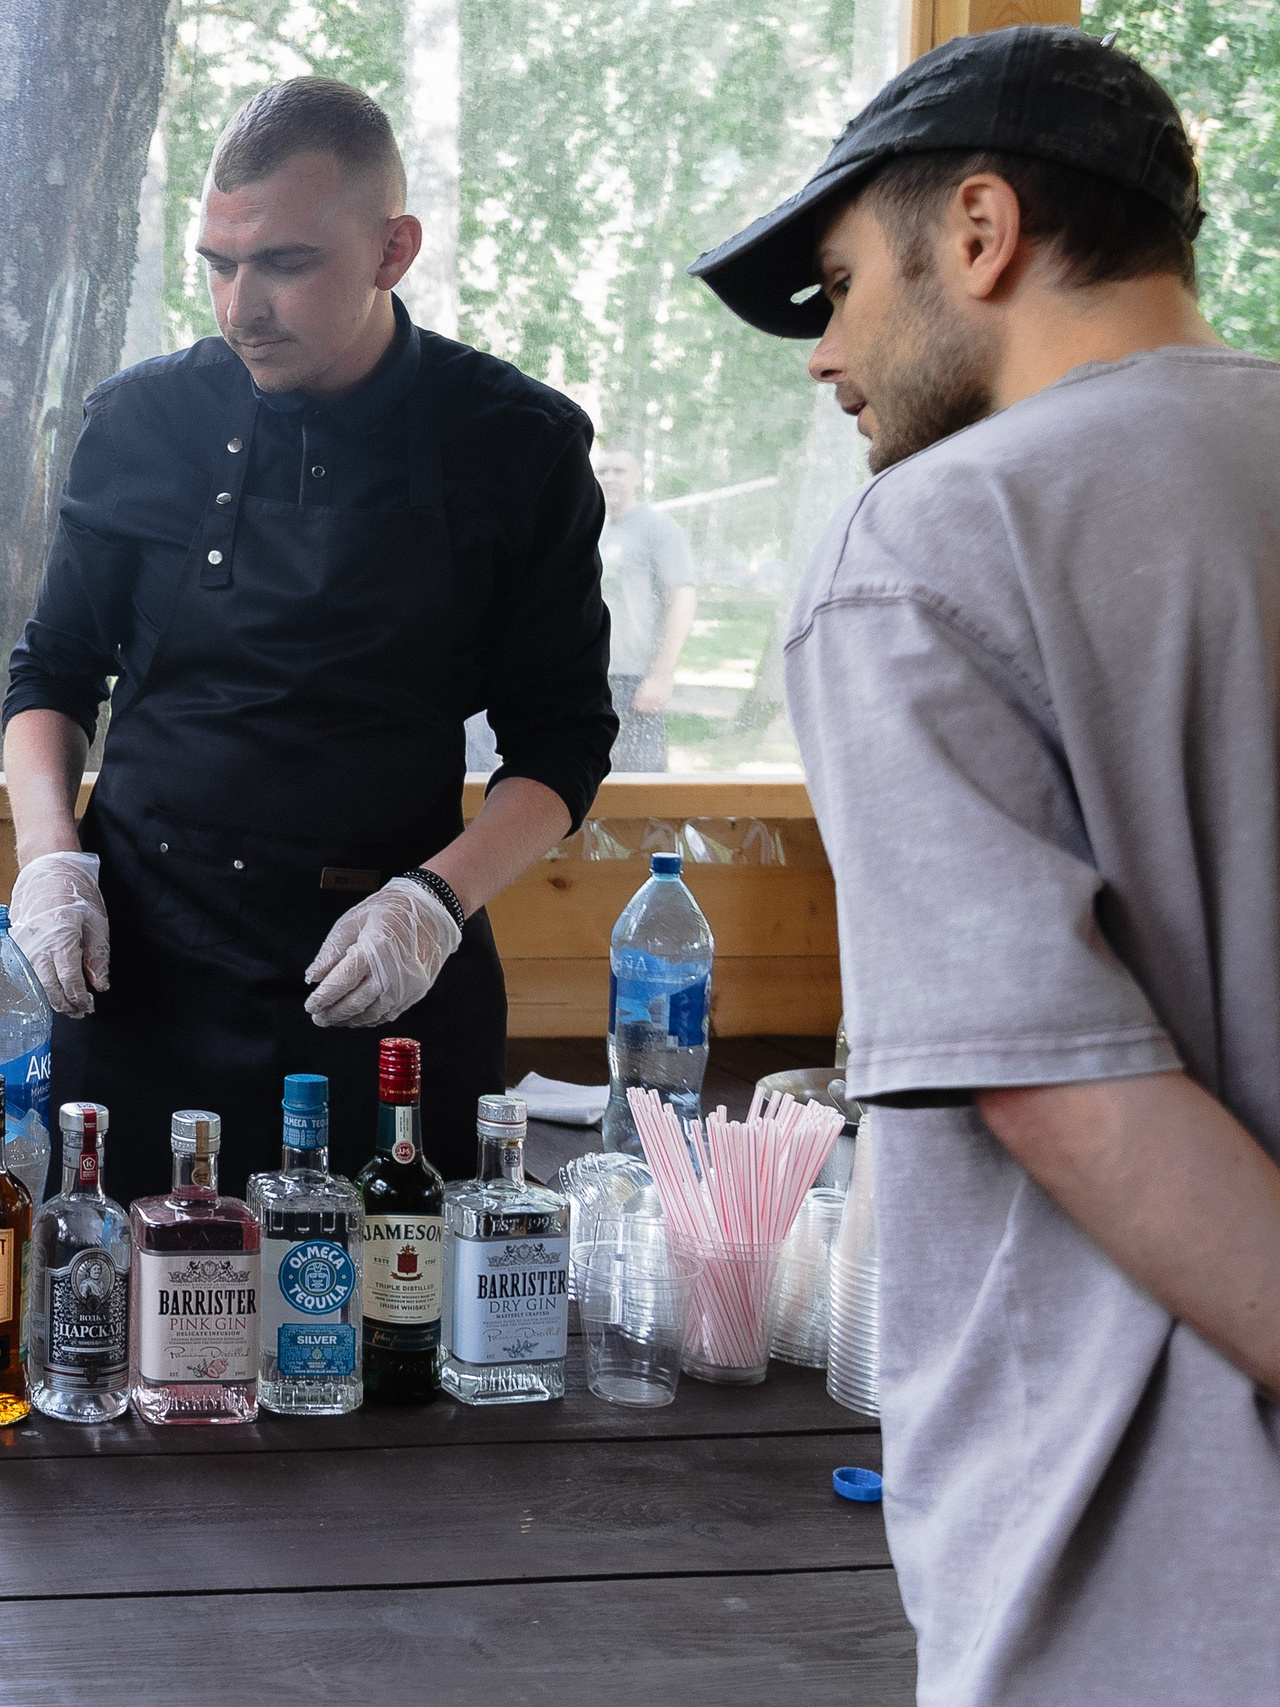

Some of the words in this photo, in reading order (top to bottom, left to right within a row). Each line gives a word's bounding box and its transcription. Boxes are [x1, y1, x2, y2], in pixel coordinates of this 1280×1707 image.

[363, 1223, 442, 1243] JAMESON
[289, 1245, 346, 1270] OLMECA
[375, 1281, 400, 1291] TRIPLE
[402, 1284, 435, 1292] DISTILLED
[477, 1269, 567, 1300] BARRISTER
[158, 1288, 257, 1316] BARRISTER
[288, 1284, 348, 1310] TEQUILA
[489, 1299, 522, 1314] DRY
[526, 1297, 557, 1311] GIN
[380, 1302, 399, 1310] IRISH
[79, 1313, 107, 1322] ВОДКА
[170, 1317, 211, 1331] PINK
[214, 1317, 247, 1331] GIN
[59, 1321, 123, 1339] ЦАРСКАЯ
[296, 1335, 337, 1345] SILVER
